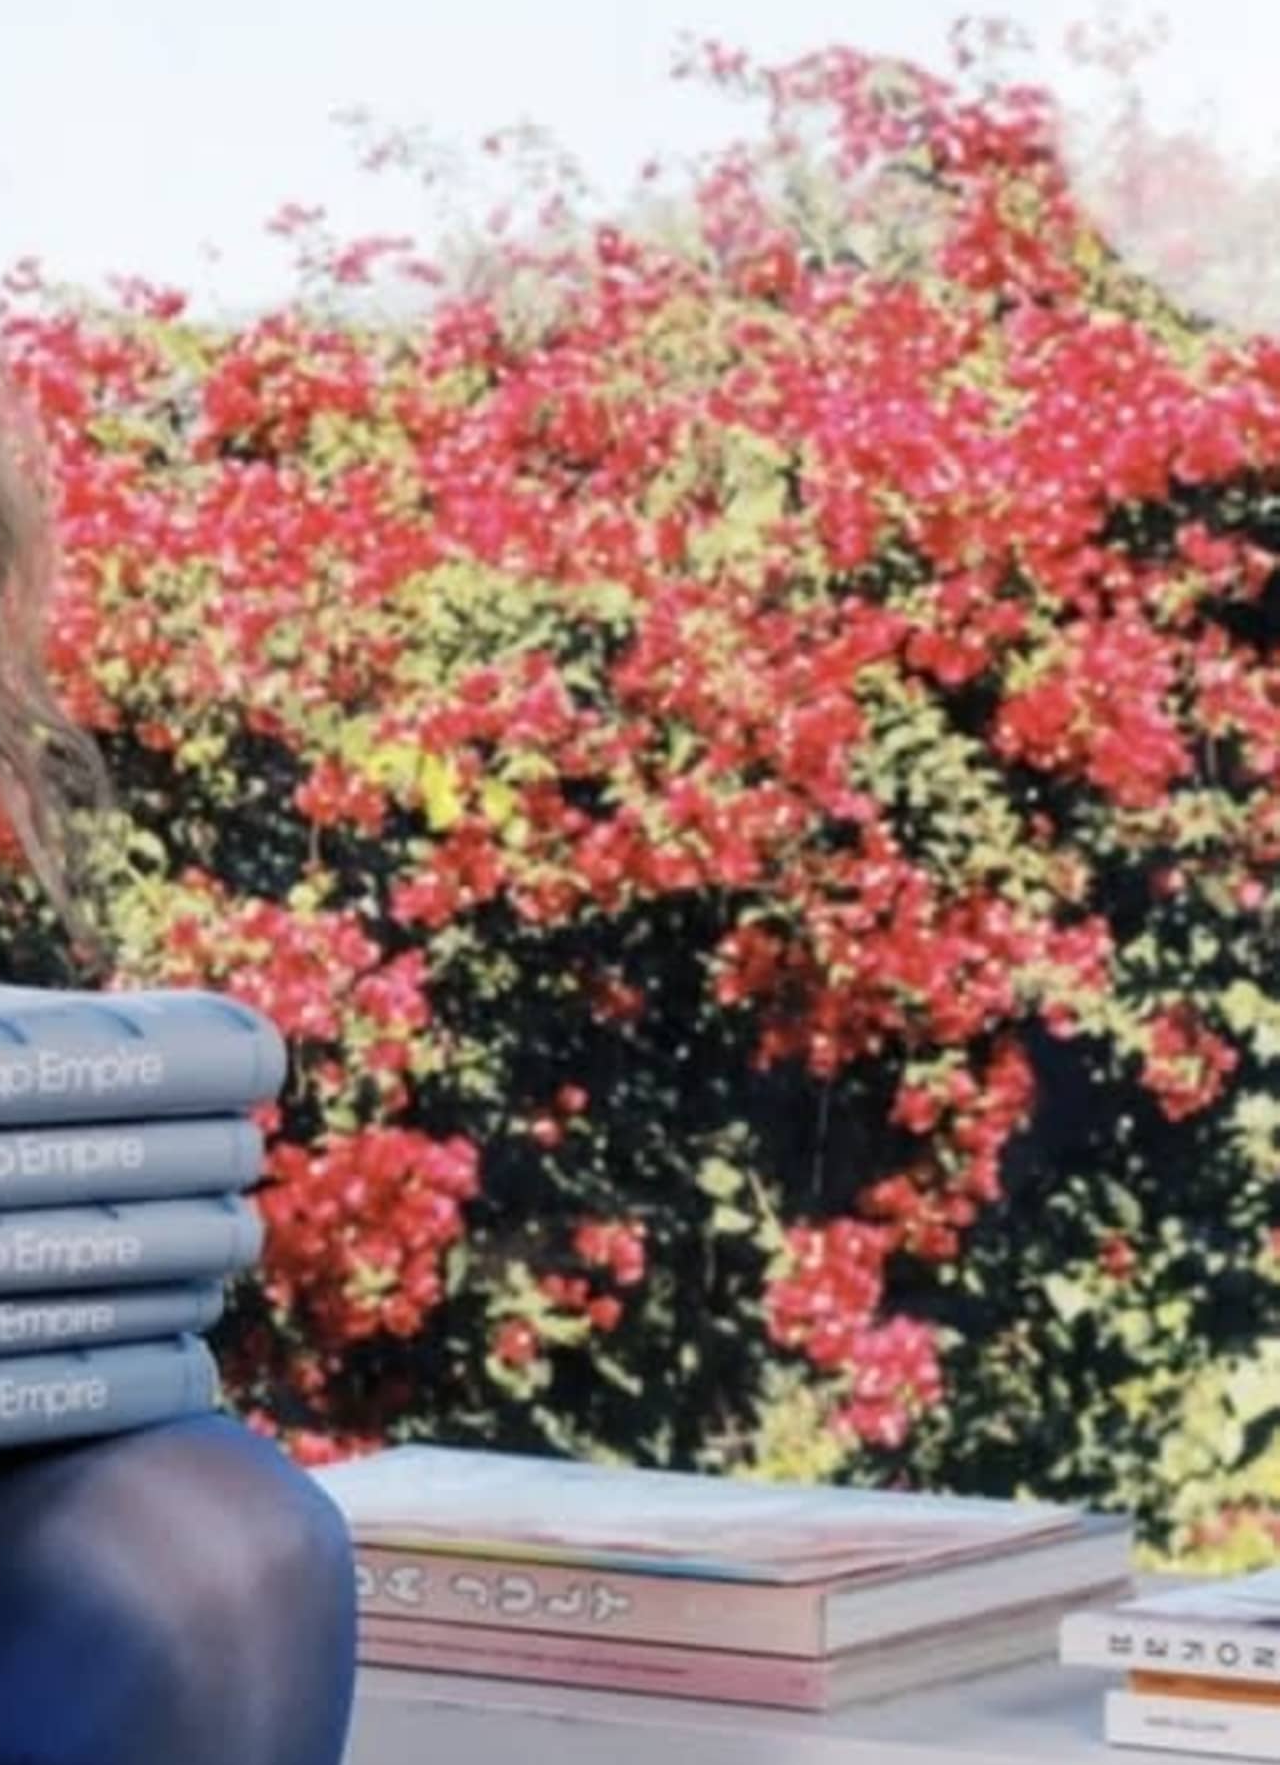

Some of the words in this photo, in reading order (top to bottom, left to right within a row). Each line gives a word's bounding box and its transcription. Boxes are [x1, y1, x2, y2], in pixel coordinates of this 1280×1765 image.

[38, 1051, 164, 1091] Empire
[17, 1135, 145, 1173] Empire
[15, 1230, 140, 1269] Empire
